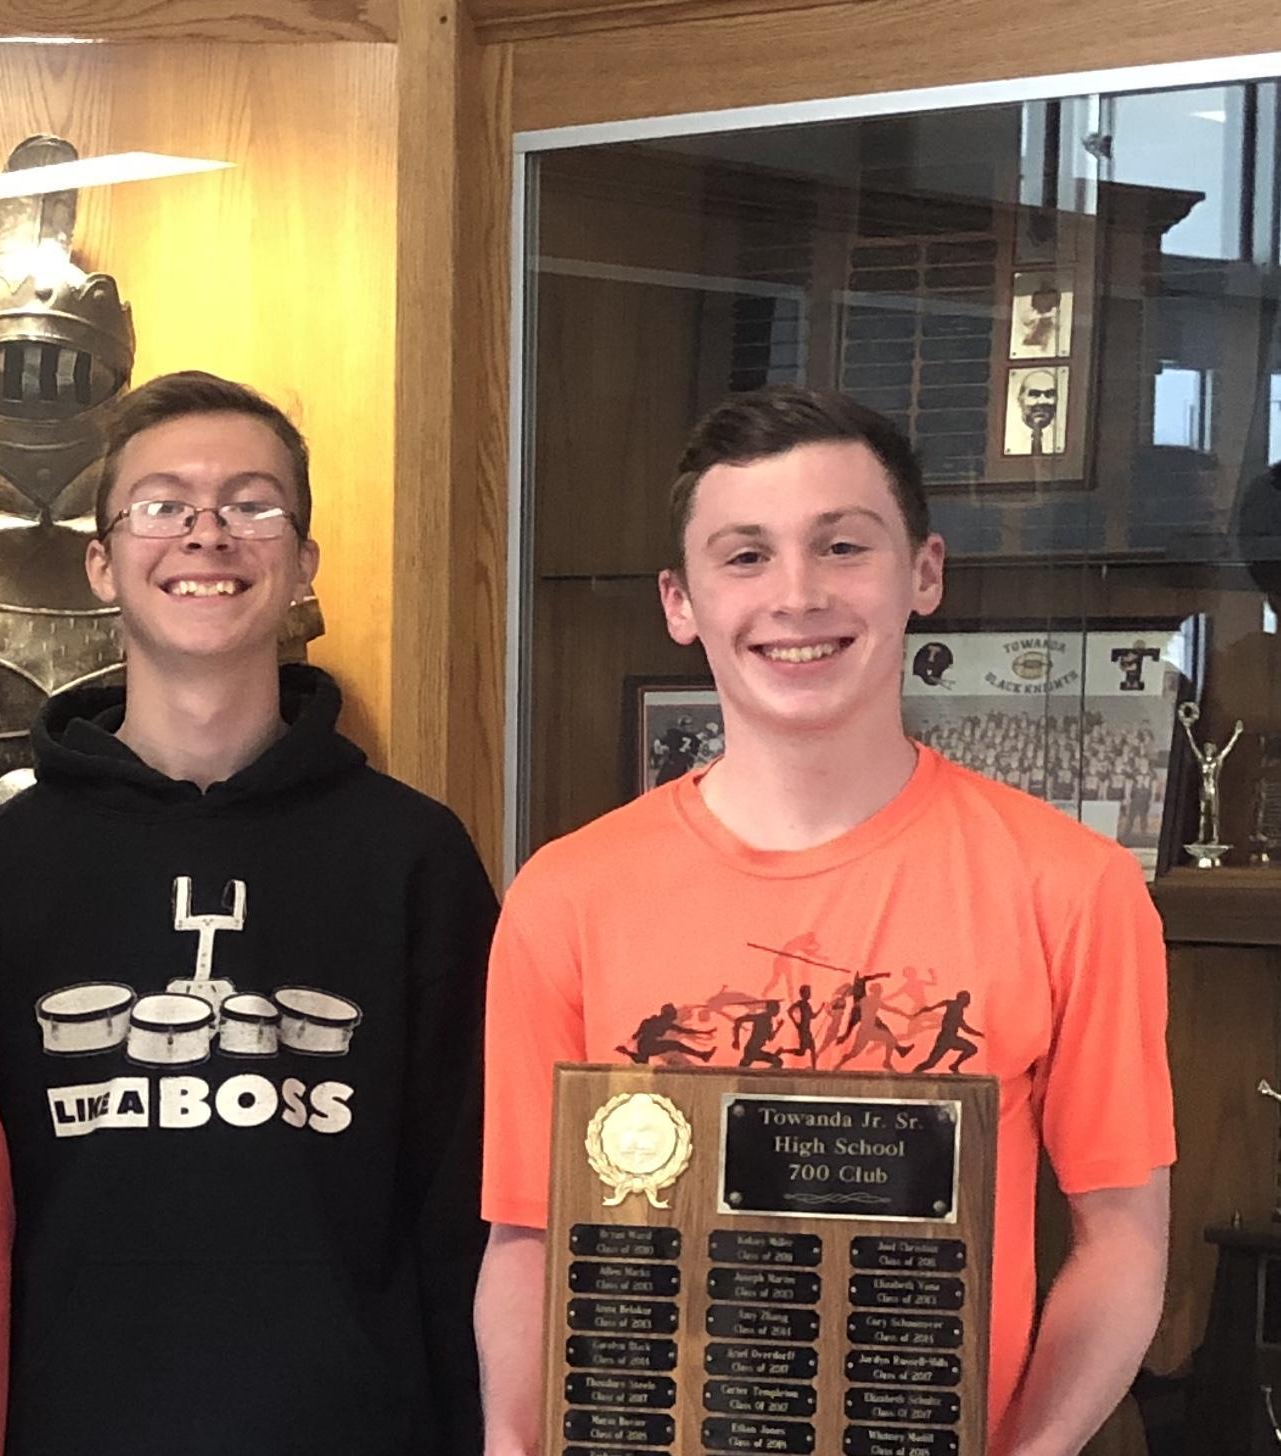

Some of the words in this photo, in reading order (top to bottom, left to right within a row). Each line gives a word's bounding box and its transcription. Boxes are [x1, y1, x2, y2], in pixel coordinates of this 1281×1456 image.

[1003, 639, 1066, 653] TOWANDA
[985, 672, 1022, 693] BLACK
[1024, 670, 1078, 693] KNIGHTS
[54, 1091, 111, 1124] LIKE
[159, 1073, 354, 1134] BOSS
[758, 1107, 852, 1128] Towanda
[861, 1111, 887, 1129] Jr.
[895, 1112, 924, 1130] Sr.
[774, 1136, 825, 1158] High
[835, 1138, 905, 1157] School
[789, 1164, 830, 1182] 700
[839, 1164, 888, 1184] Club
